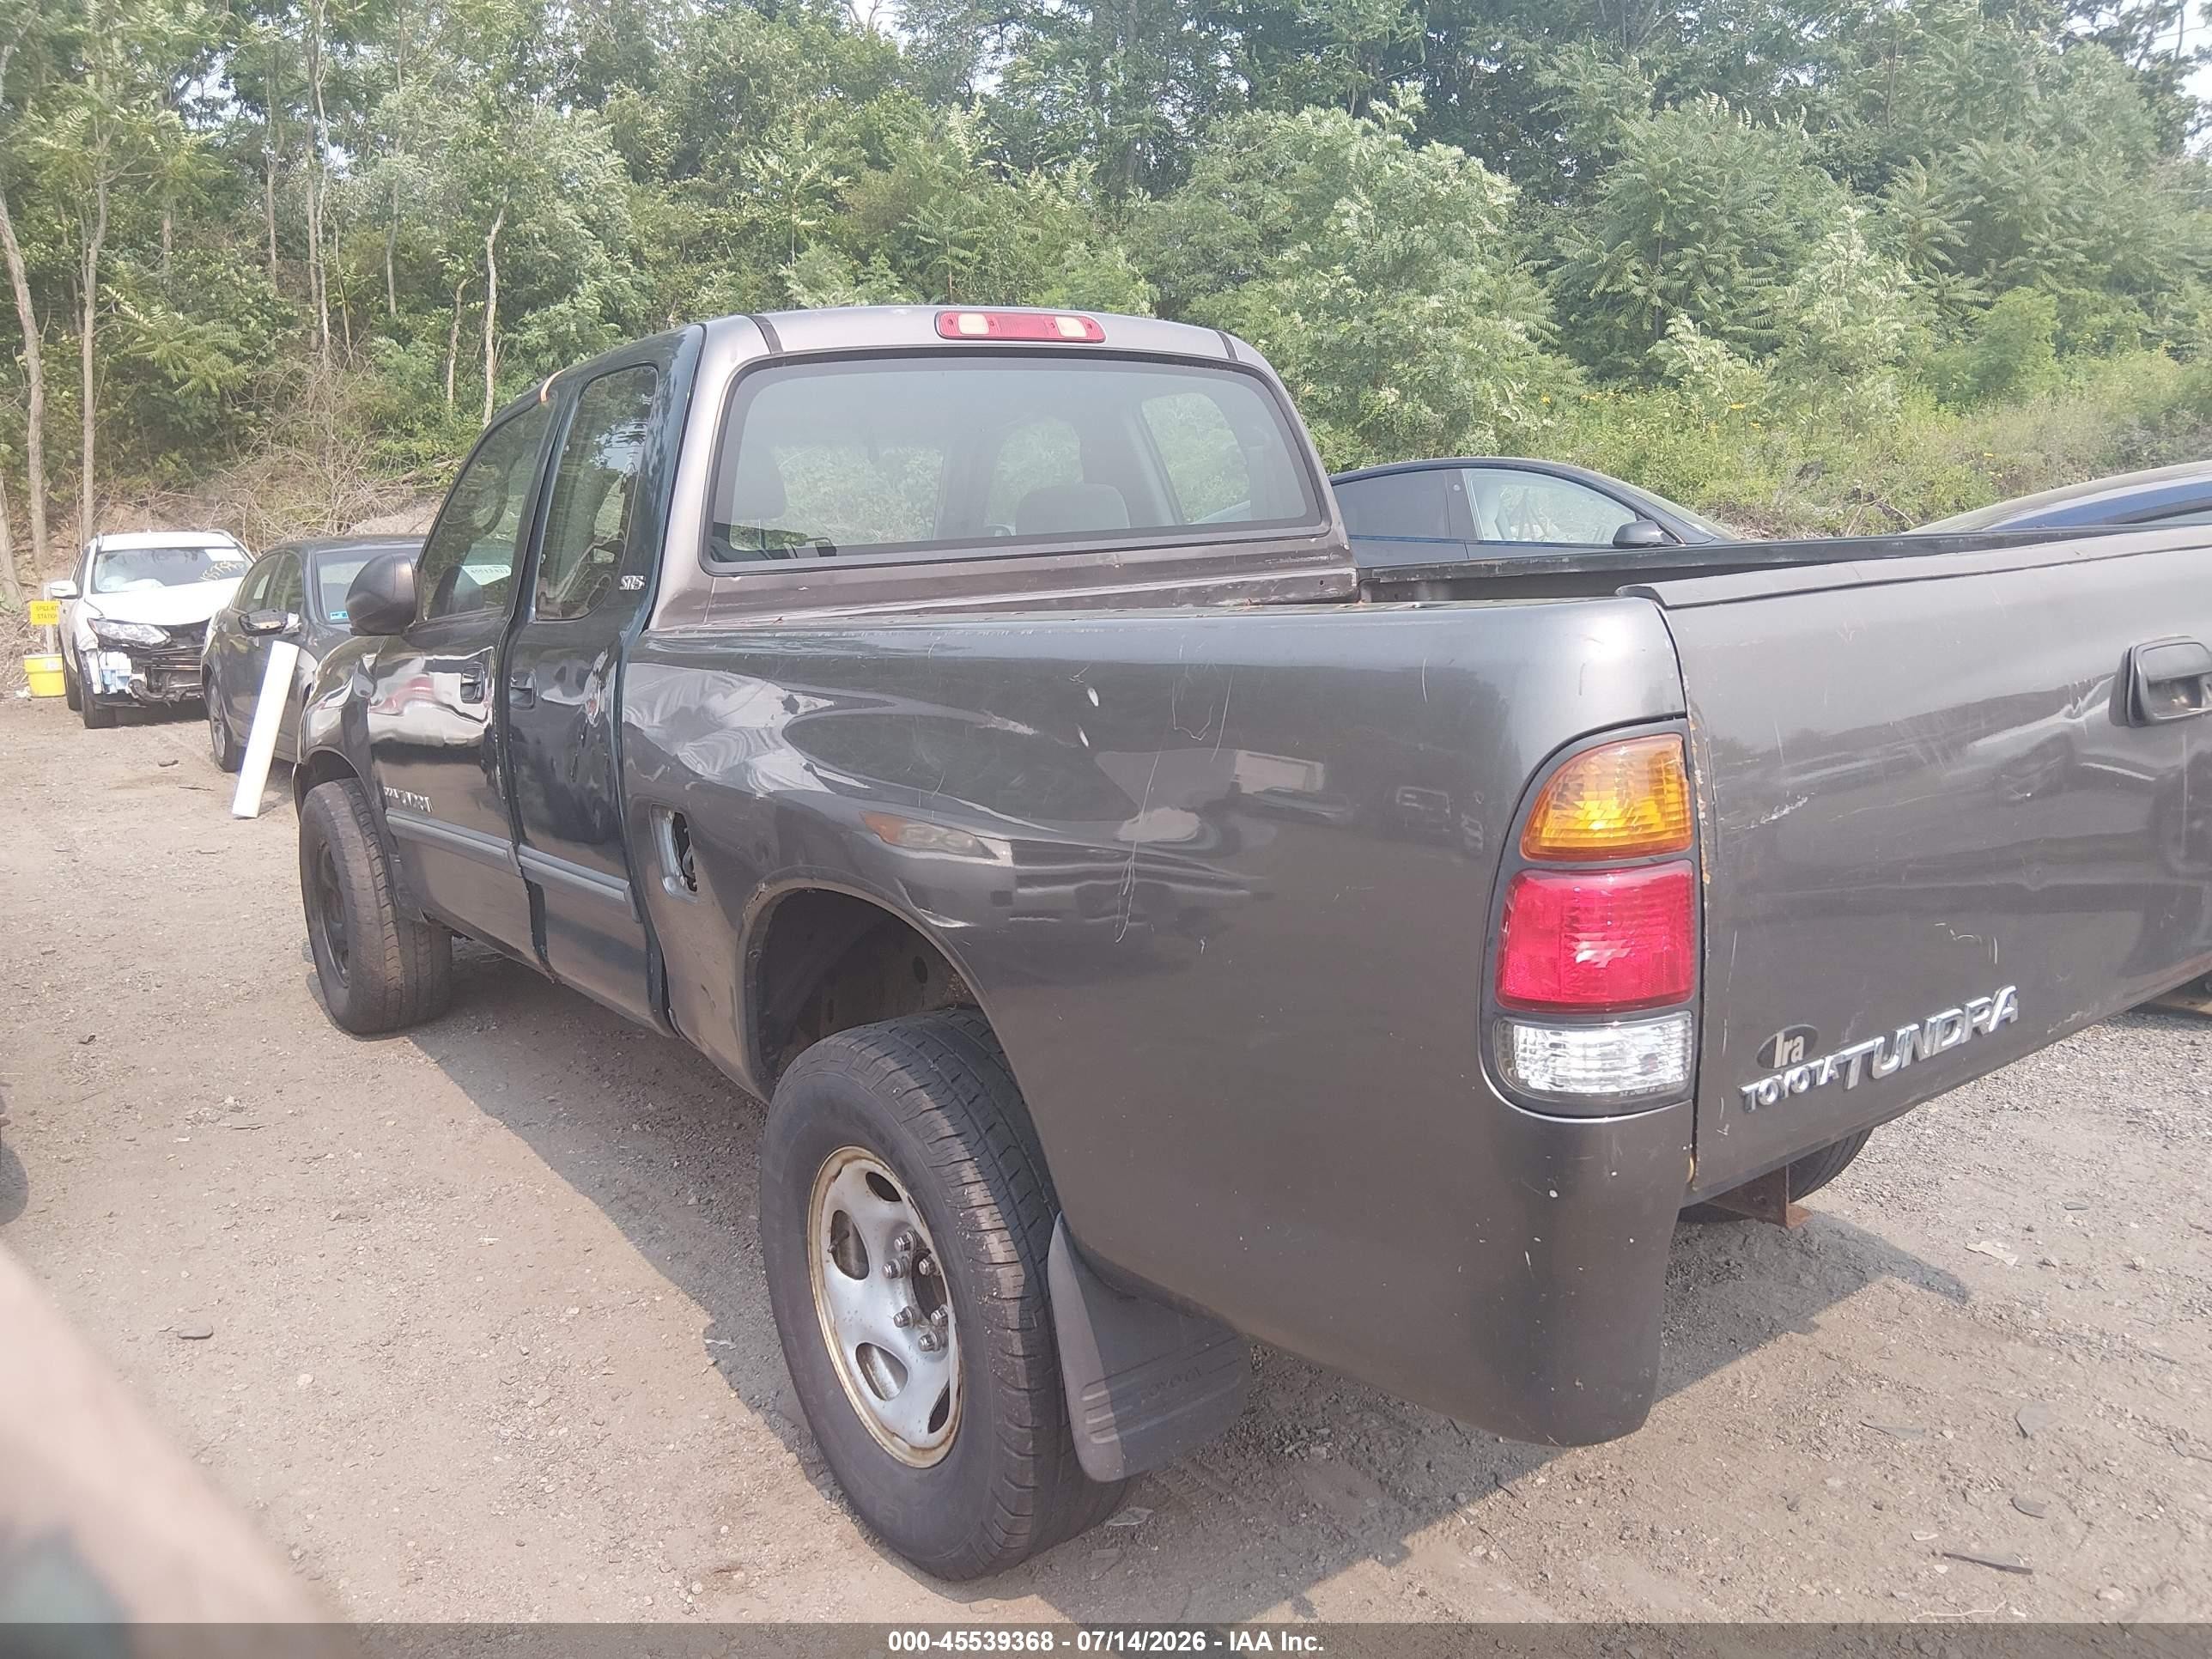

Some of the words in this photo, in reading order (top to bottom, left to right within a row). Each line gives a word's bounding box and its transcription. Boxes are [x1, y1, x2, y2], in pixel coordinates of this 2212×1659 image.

[1738, 1055, 1840, 1113] TOYOTA
[1835, 984, 2019, 1091] TUNDRA
[1772, 1031, 1806, 1069] Ira
